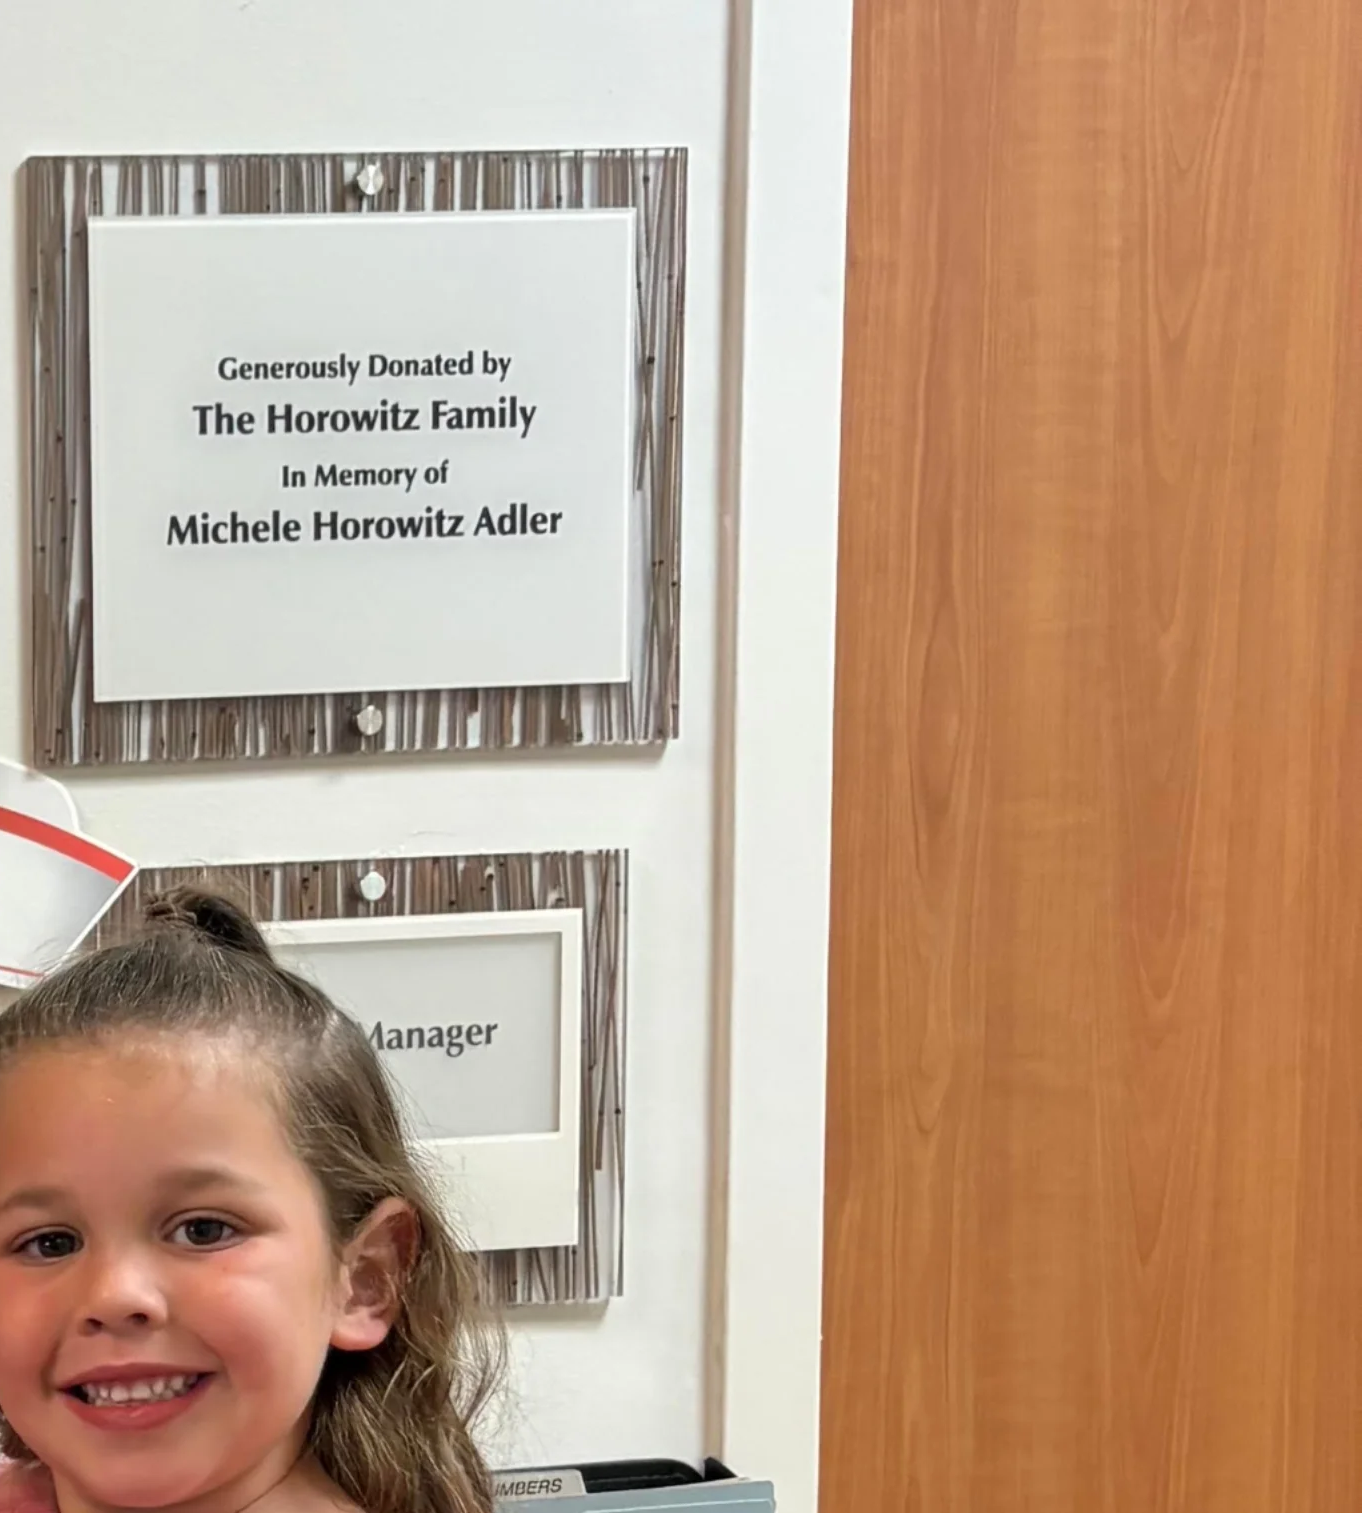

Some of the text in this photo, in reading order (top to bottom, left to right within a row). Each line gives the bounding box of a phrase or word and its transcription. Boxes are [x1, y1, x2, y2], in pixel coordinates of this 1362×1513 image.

[217, 350, 512, 386] Generously Donated by
[192, 396, 538, 438] The Horowitz Family
[282, 459, 450, 493] In Memory of
[166, 502, 564, 546] Michele Horowitz Adler
